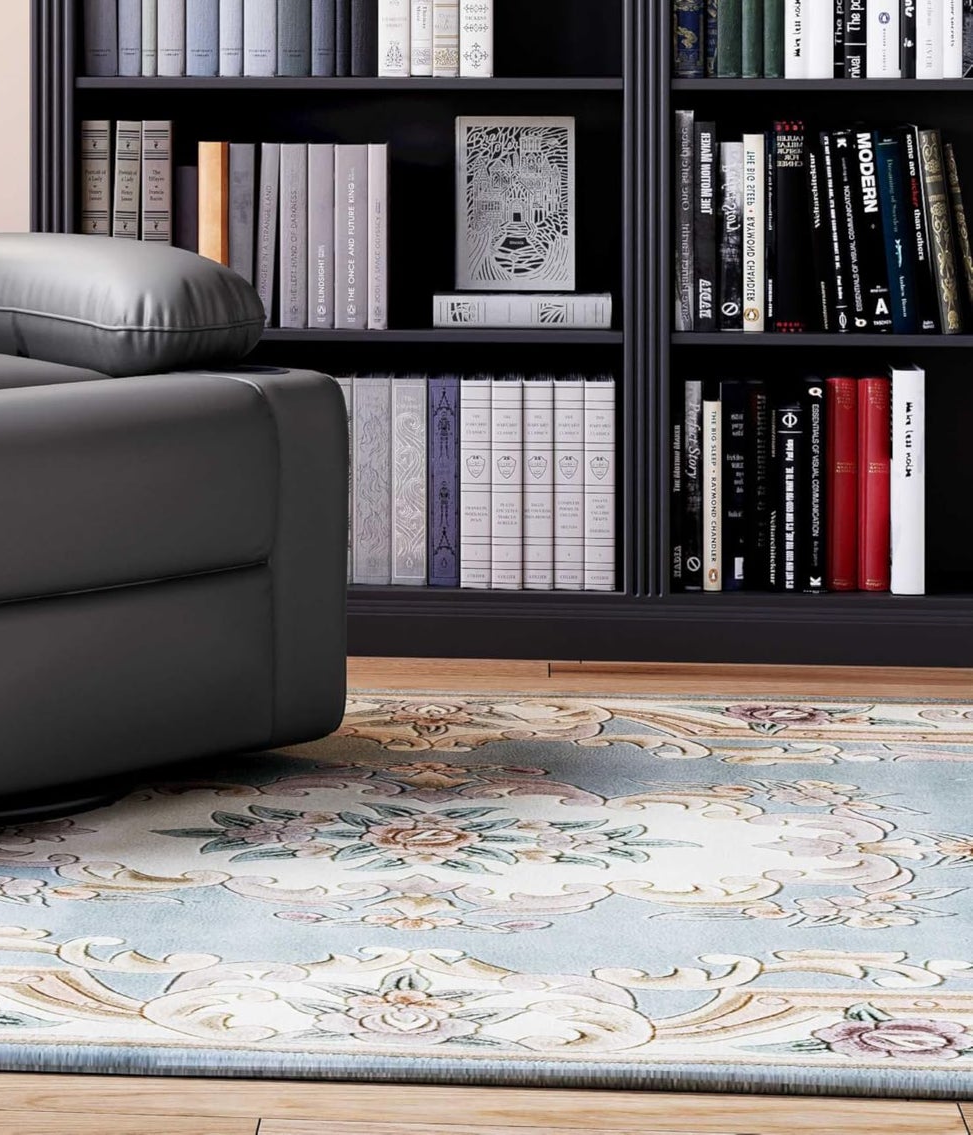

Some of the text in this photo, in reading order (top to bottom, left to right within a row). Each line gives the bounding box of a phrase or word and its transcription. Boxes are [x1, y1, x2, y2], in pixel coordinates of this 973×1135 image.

[835, 19, 843, 45] The
[847, 13, 861, 32] The
[856, 133, 877, 213] MODERN
[916, 232, 924, 260] others
[852, 264, 859, 272] OF
[685, 403, 700, 478] Perfect Story
[812, 445, 819, 454] OF
